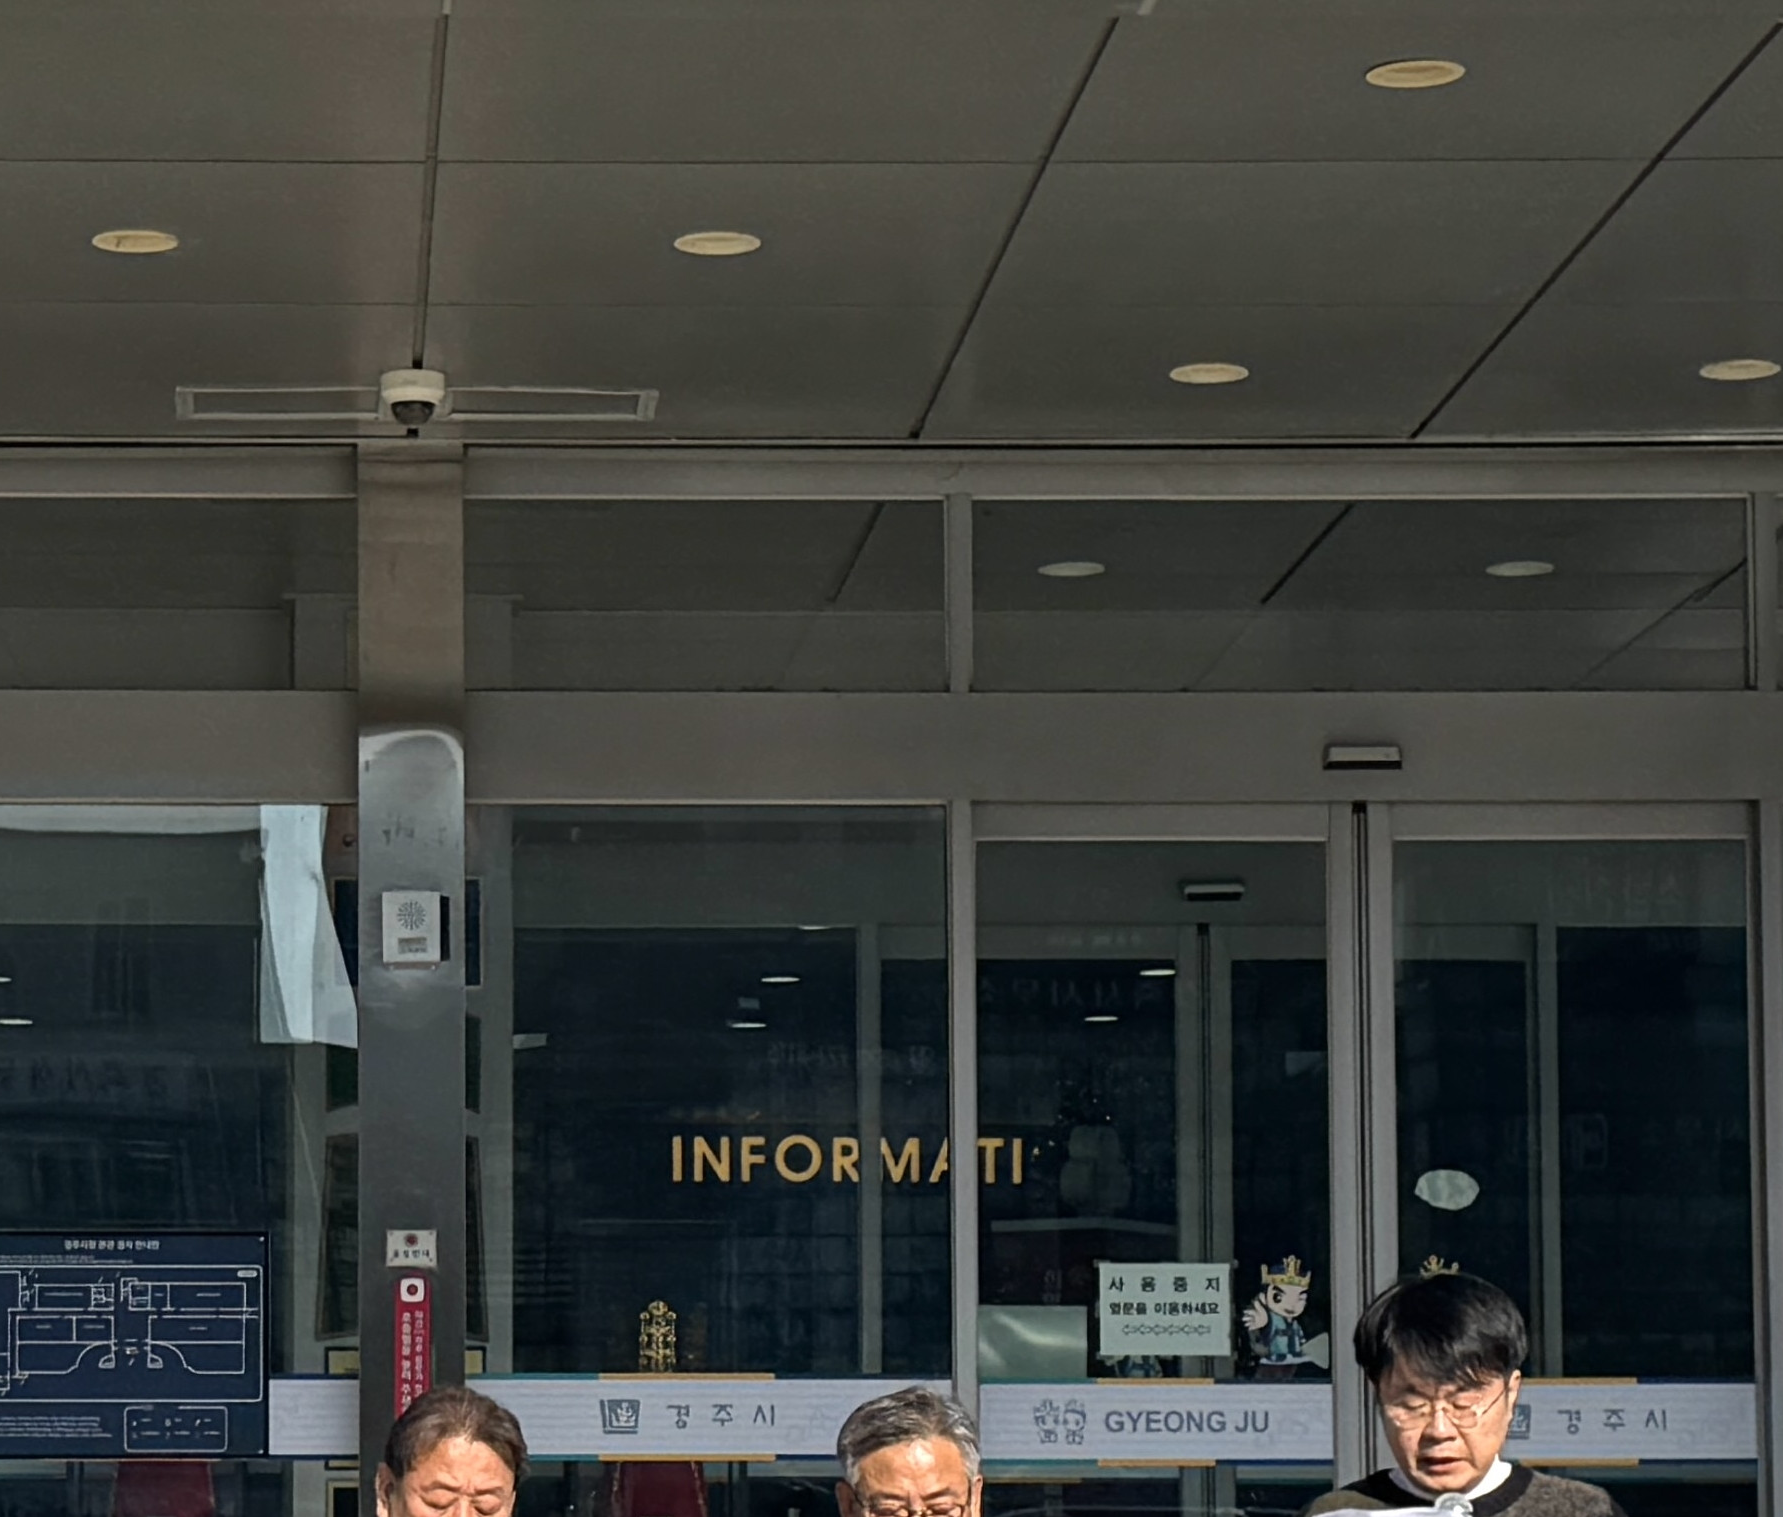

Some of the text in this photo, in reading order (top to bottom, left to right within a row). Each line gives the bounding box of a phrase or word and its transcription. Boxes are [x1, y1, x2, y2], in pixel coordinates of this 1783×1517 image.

[1153, 1301, 1220, 1316] 이용하세요
[666, 1404, 775, 1430] 경주시
[1104, 1410, 1270, 1433] GYEONG JU
[1557, 1408, 1667, 1435] 경주시
